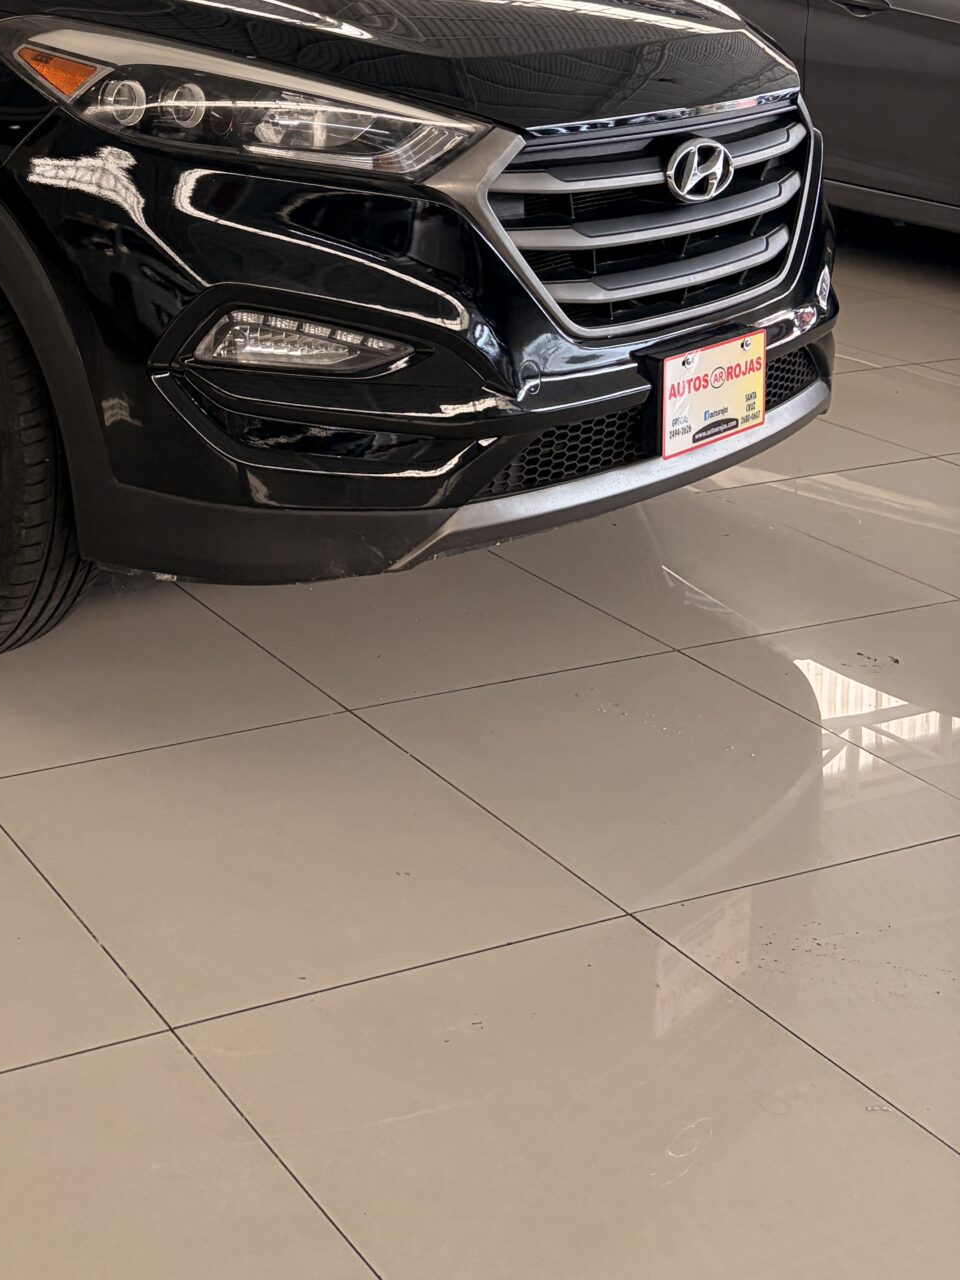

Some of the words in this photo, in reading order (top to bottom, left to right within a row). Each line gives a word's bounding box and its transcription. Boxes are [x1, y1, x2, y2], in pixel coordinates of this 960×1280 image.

[668, 373, 709, 400] AUTOS
[713, 371, 724, 383] AR
[726, 356, 762, 381] ROJAS
[745, 392, 757, 402] SANTA
[745, 401, 756, 412] CRUZ
